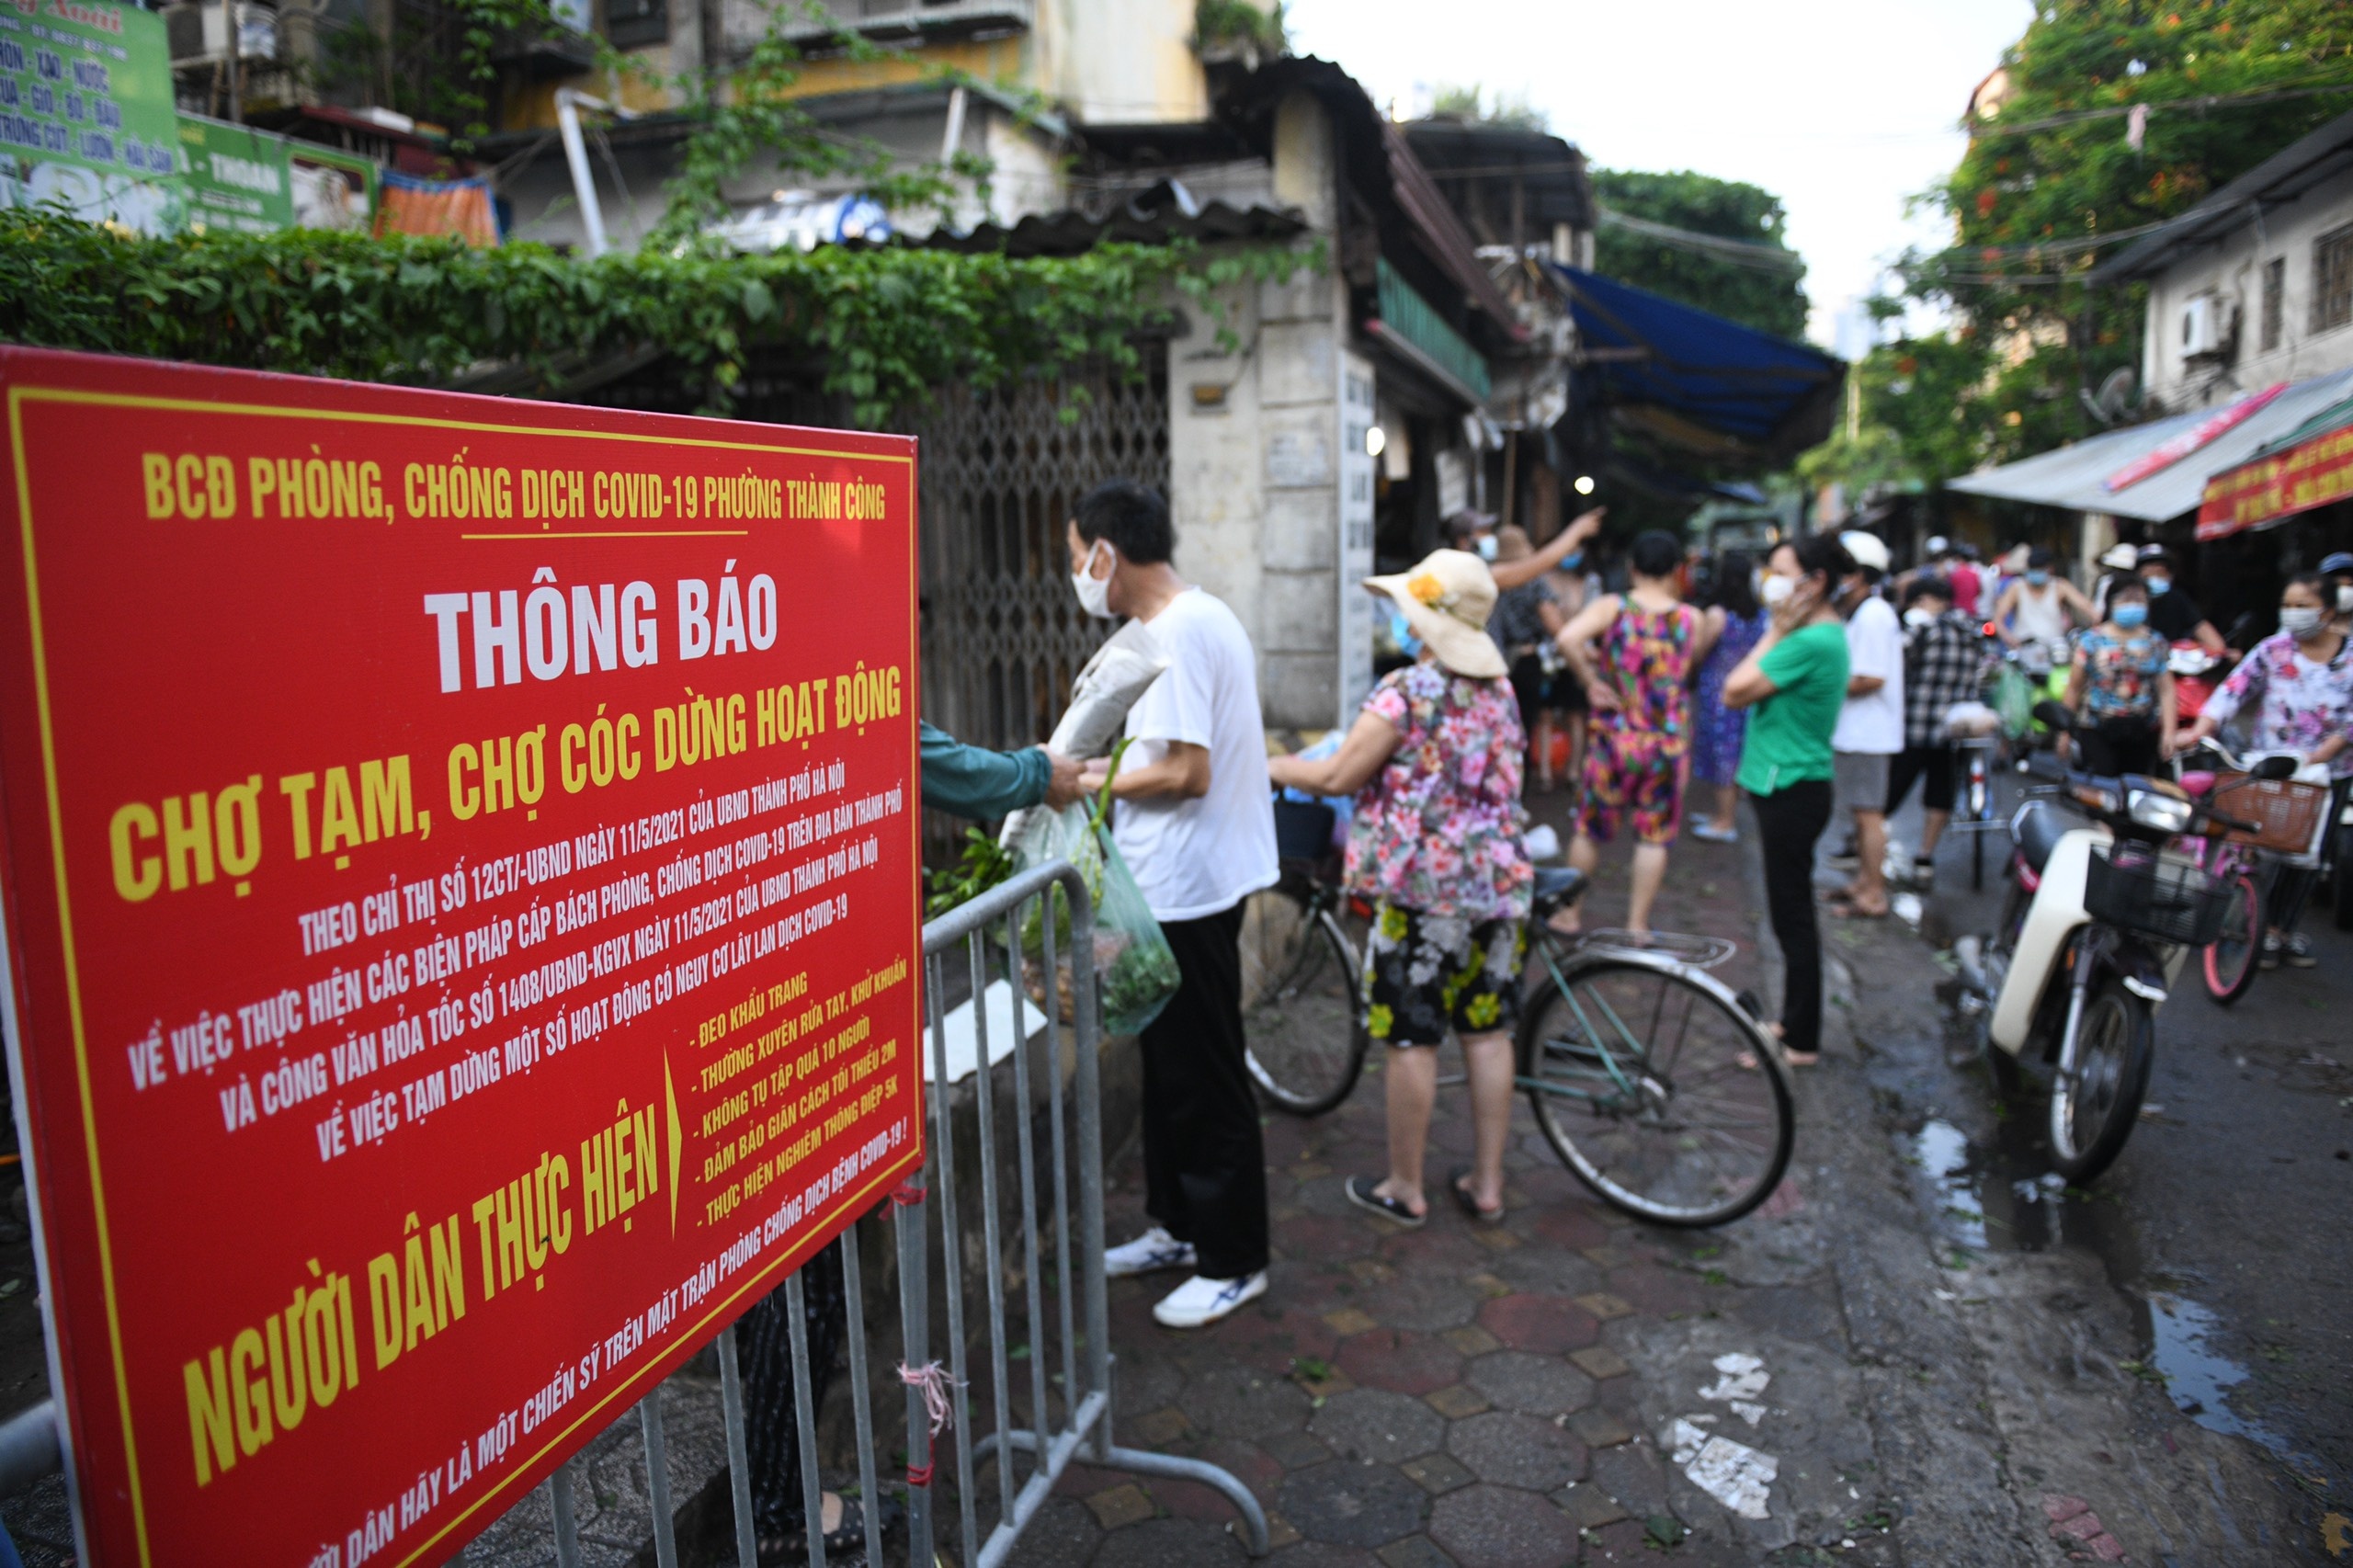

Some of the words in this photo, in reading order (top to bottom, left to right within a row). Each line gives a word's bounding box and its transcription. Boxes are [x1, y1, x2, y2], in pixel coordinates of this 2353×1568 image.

[142, 453, 236, 519] BCĐ
[249, 444, 394, 524] PHÒNG,
[404, 447, 512, 518] CHỐNG
[521, 470, 585, 529] DỊCH
[594, 472, 698, 518] COVID-19
[704, 467, 781, 518] PHƯỜNG
[787, 473, 840, 519] THÀNH
[846, 476, 885, 519] CÔNG
[424, 567, 658, 693] THÔNG
[677, 559, 777, 660] BÁO
[110, 775, 262, 902] CHỢ
[280, 755, 430, 869] TẠM,
[449, 724, 546, 821] CHỢ
[561, 703, 641, 793] CÓC
[654, 687, 746, 772] DỪNG
[756, 678, 827, 750] HOẠT
[835, 661, 901, 735] ĐỘNG
[299, 902, 358, 956] THEO
[363, 874, 399, 936] CHỈ
[404, 879, 436, 925] THỊ
[441, 857, 466, 912] SỐ
[472, 841, 571, 902] 12CT/-UBND
[575, 824, 615, 870] NGÀY
[620, 809, 684, 856] 11/5/2021
[689, 789, 714, 835] CỦA
[717, 790, 749, 825] UBND
[752, 777, 787, 814] THÀNH
[790, 762, 810, 803] PHỐ
[813, 762, 826, 796] HÀ
[828, 757, 845, 795] NỘI
[129, 1019, 166, 1090] VỀ
[171, 1011, 233, 1074] VIỆC
[238, 989, 302, 1050] THỰC
[308, 967, 362, 1025] HIỆN
[368, 950, 410, 1003] CÁC
[415, 934, 460, 987] BIỆN
[465, 915, 513, 968] PHÁP
[518, 903, 551, 949] CẤP
[556, 890, 597, 935] BÁCH
[601, 871, 654, 918] PHÒNG,
[657, 855, 701, 898] CHỐNG
[704, 844, 733, 885] DỊCH
[735, 826, 785, 869] COVID-19
[787, 813, 813, 850] TRÊN
[815, 811, 832, 844] ĐỊA
[834, 801, 853, 834] BÀN
[855, 793, 883, 825] THÀNH
[885, 779, 902, 815] PHỐ
[221, 1074, 256, 1131] VÀ
[261, 1053, 328, 1115] CÔNG
[332, 1032, 378, 1085] VĂN
[382, 1005, 425, 1065] HỎA
[427, 989, 465, 1045] TỐC
[470, 973, 494, 1028] SỐ
[499, 933, 631, 1017] 1408/UBND-KGVX
[635, 915, 670, 960] NGÀY
[675, 894, 732, 943] 11/5/2021
[736, 875, 759, 918] CỦA
[762, 871, 790, 907] UBND
[793, 858, 825, 894] THÀNH
[827, 840, 847, 881] PHỐ
[848, 839, 861, 871] HÀ
[862, 834, 878, 869] NỘI
[699, 1014, 726, 1048] ĐEO
[731, 987, 765, 1031] KHẨU
[768, 971, 807, 1010] TRANG
[317, 1100, 347, 1162] VỀ
[350, 1090, 398, 1146] VIỆC
[403, 1071, 446, 1125] TẠM
[450, 1047, 501, 1100] DỪNG
[505, 1026, 540, 1075] MỘT
[546, 1004, 566, 1056] SỐ
[571, 997, 608, 1044] HOẠT
[613, 980, 651, 1027] ĐỘNG
[655, 964, 672, 1005] CÓ
[676, 953, 709, 995] NGUY
[712, 942, 728, 978] CƠ
[732, 932, 751, 970] LÂY
[755, 924, 776, 959] LAN
[779, 913, 802, 950] DỊCH
[804, 893, 847, 935] COVID-19
[701, 1043, 754, 1092] THƯỜNG
[758, 1019, 797, 1060] XUYÊN
[801, 999, 823, 1035] RỬA
[852, 969, 872, 1006] KHỬ
[874, 954, 906, 993] KHUẨN
[703, 1091, 748, 1138] KHÔNG
[752, 1079, 767, 1107] TỤ
[770, 1063, 793, 1095] TẬP
[797, 1048, 819, 1080] QUÁ
[823, 1038, 835, 1062] 10
[838, 1017, 870, 1053] NGƯỜI
[705, 1142, 735, 1183] ĐẢM
[739, 1120, 764, 1159] BẢO
[768, 1103, 796, 1140] GIÃN
[800, 1082, 829, 1118] CÁCH
[832, 1063, 848, 1096] TỐI
[851, 1043, 879, 1083] THIỂU
[881, 1040, 896, 1064] 2M
[706, 1184, 740, 1225] THỰC
[745, 1161, 773, 1199] HIỆN
[777, 1127, 821, 1176] NGHIÊM
[824, 1101, 858, 1140] THÔNG
[860, 1085, 883, 1115] ĐIỆP
[885, 1075, 897, 1098] 5K
[184, 1258, 358, 1486] NGƯỜI
[369, 1211, 465, 1369] DÂN
[472, 1152, 572, 1301] THỰC
[581, 1098, 658, 1235] HIỆN
[347, 1504, 394, 1568] DÂN
[402, 1467, 441, 1530] HÃY
[449, 1441, 472, 1494] LÀ
[478, 1410, 517, 1471] MỘT
[524, 1362, 574, 1434] CHIẾN
[580, 1342, 600, 1390] SỸ
[605, 1315, 643, 1370] TRÊN
[648, 1289, 678, 1338] MẶT
[682, 1259, 716, 1311] TRẬN
[720, 1226, 761, 1281] PHÒNG
[764, 1195, 802, 1245] CHỐNG
[805, 1174, 830, 1215] DỊCH
[832, 1152, 858, 1193] BỆNH
[860, 1121, 902, 1170] COVID-19
